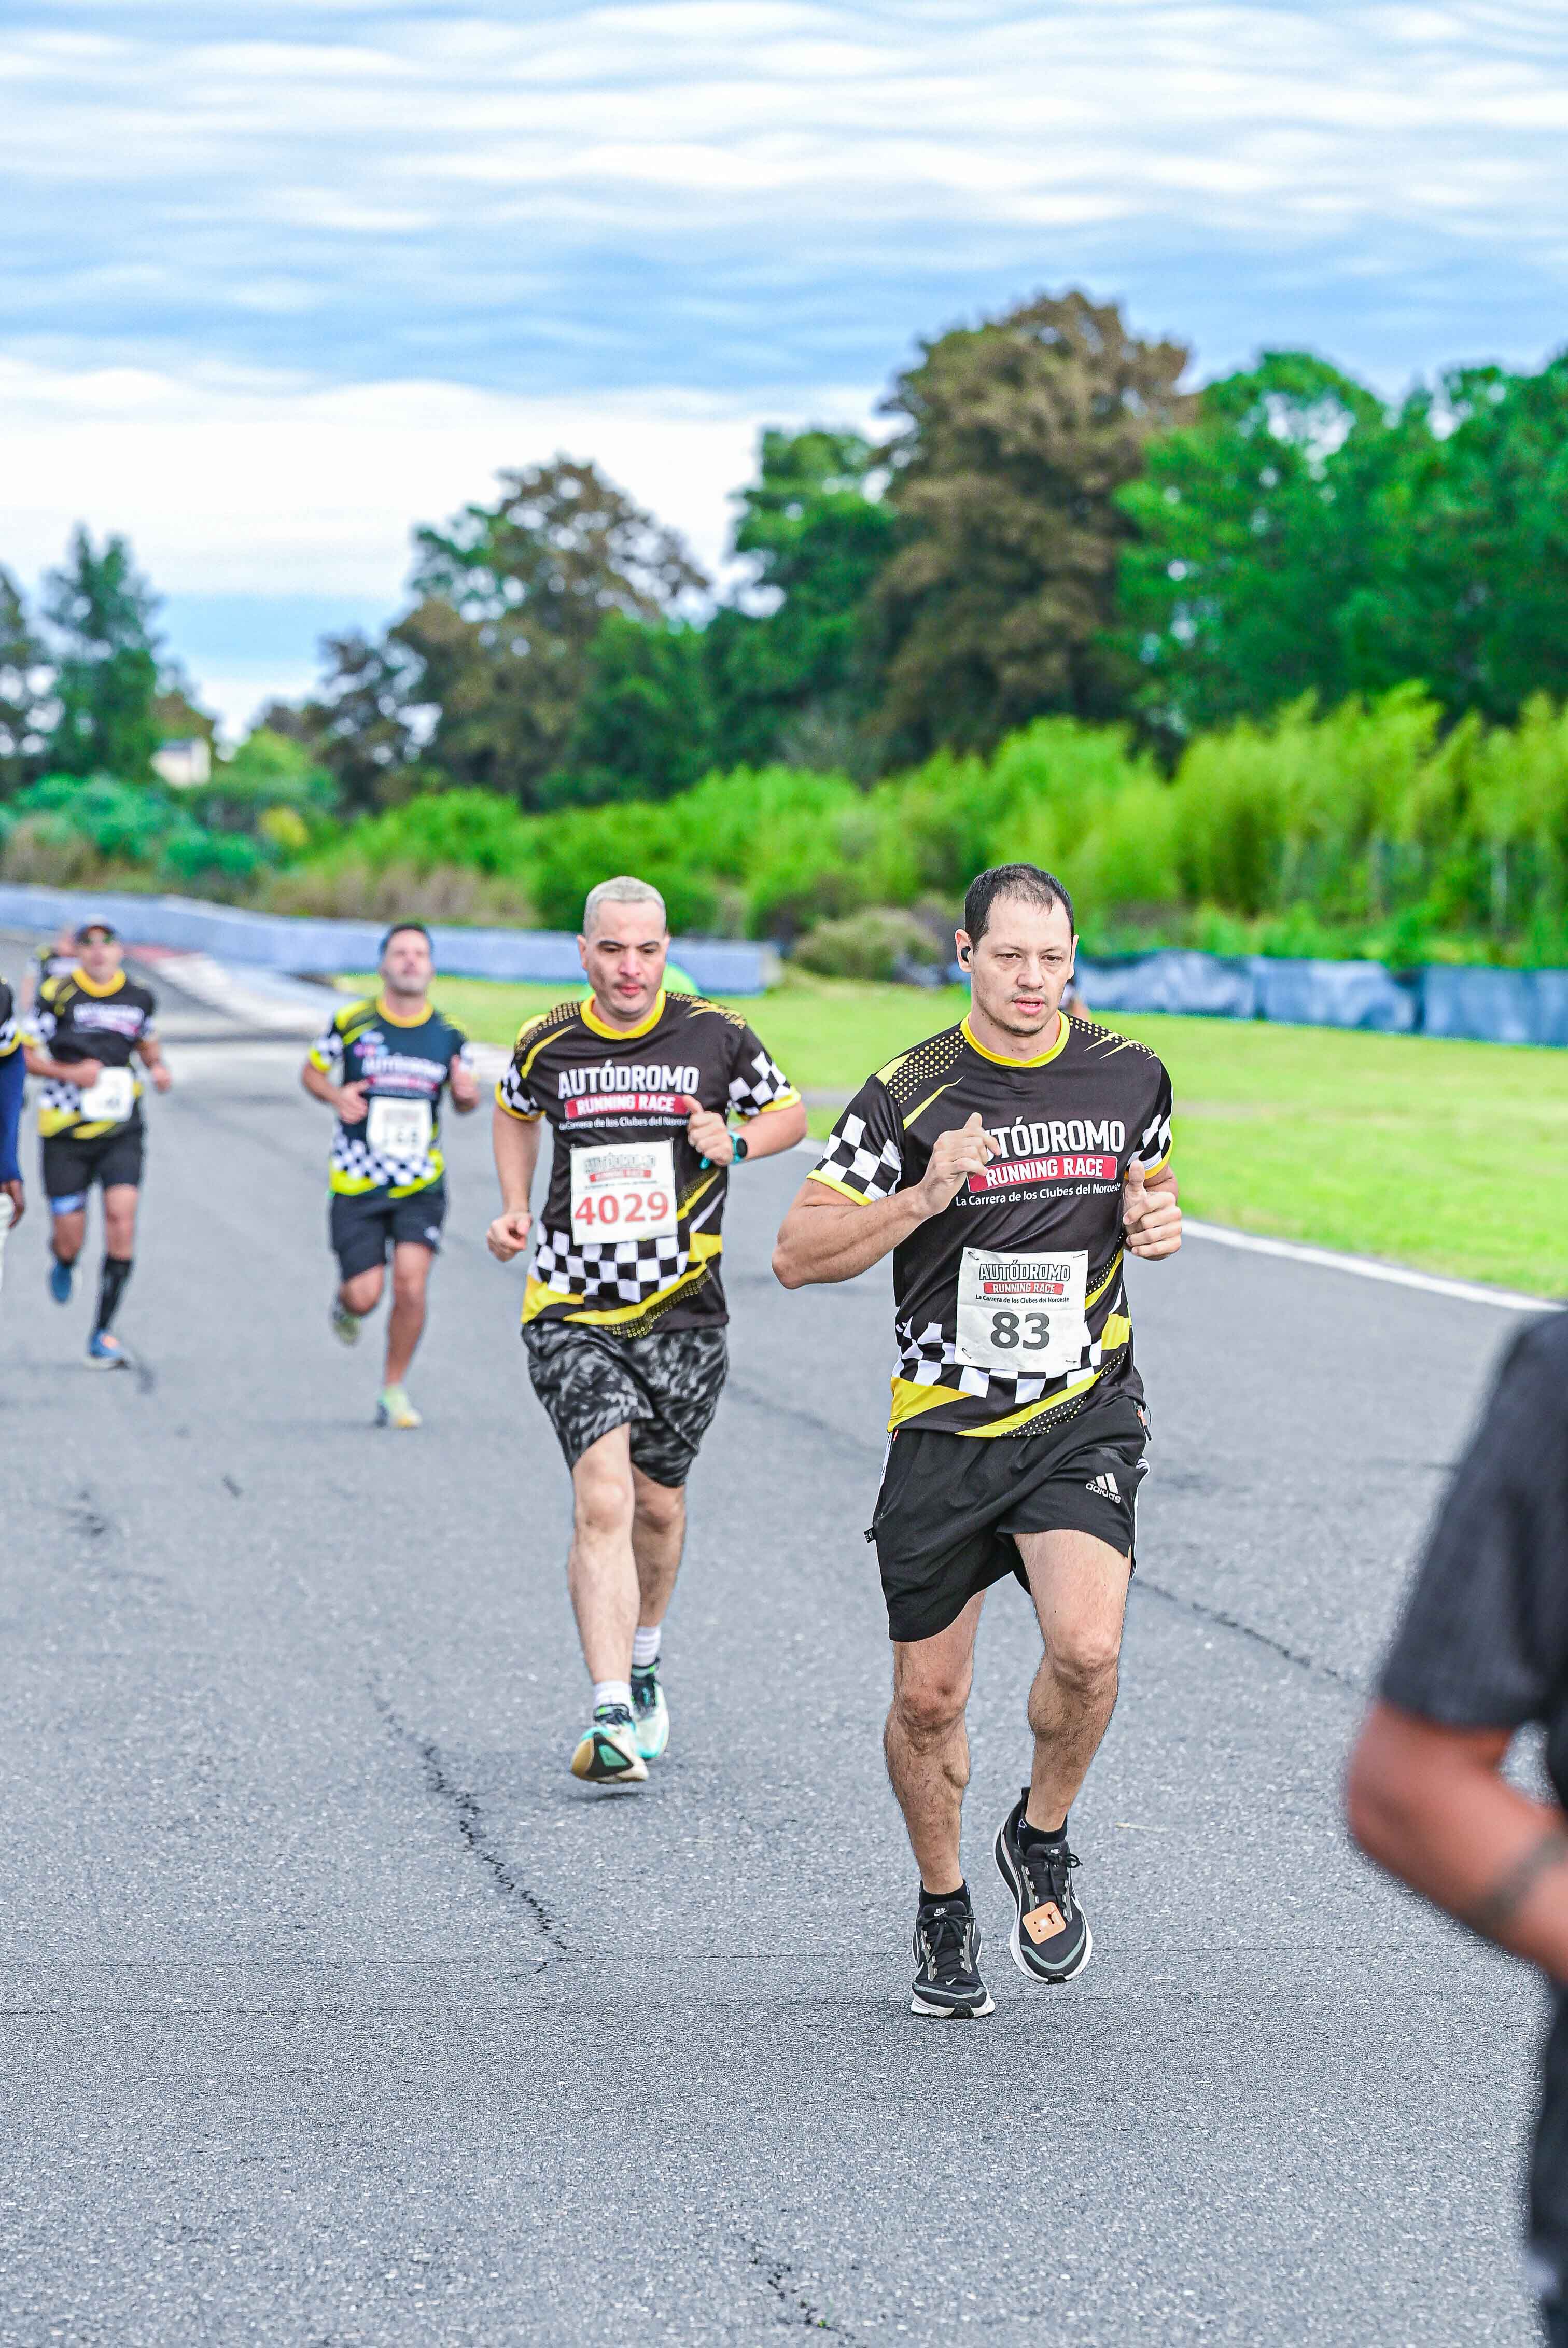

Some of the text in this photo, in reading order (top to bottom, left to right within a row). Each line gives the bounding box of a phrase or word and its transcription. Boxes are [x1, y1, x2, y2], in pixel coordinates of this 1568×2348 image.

[558, 1059, 700, 1099] AUTÓDROMO
[577, 1094, 675, 1115] RUNNING RACE
[985, 1116, 1125, 1162] TÓDROMO
[986, 1157, 1104, 1187] RUNNING RACE
[956, 1182, 1121, 1207] La Carrera de los Clubes del Noroeste
[575, 1191, 669, 1226] 4029
[979, 1259, 1071, 1281] AUTÓDROMO
[992, 1283, 1055, 1293] RUNNING RACE
[990, 1311, 1050, 1350] 83
[1085, 1482, 1121, 1504] adidas
